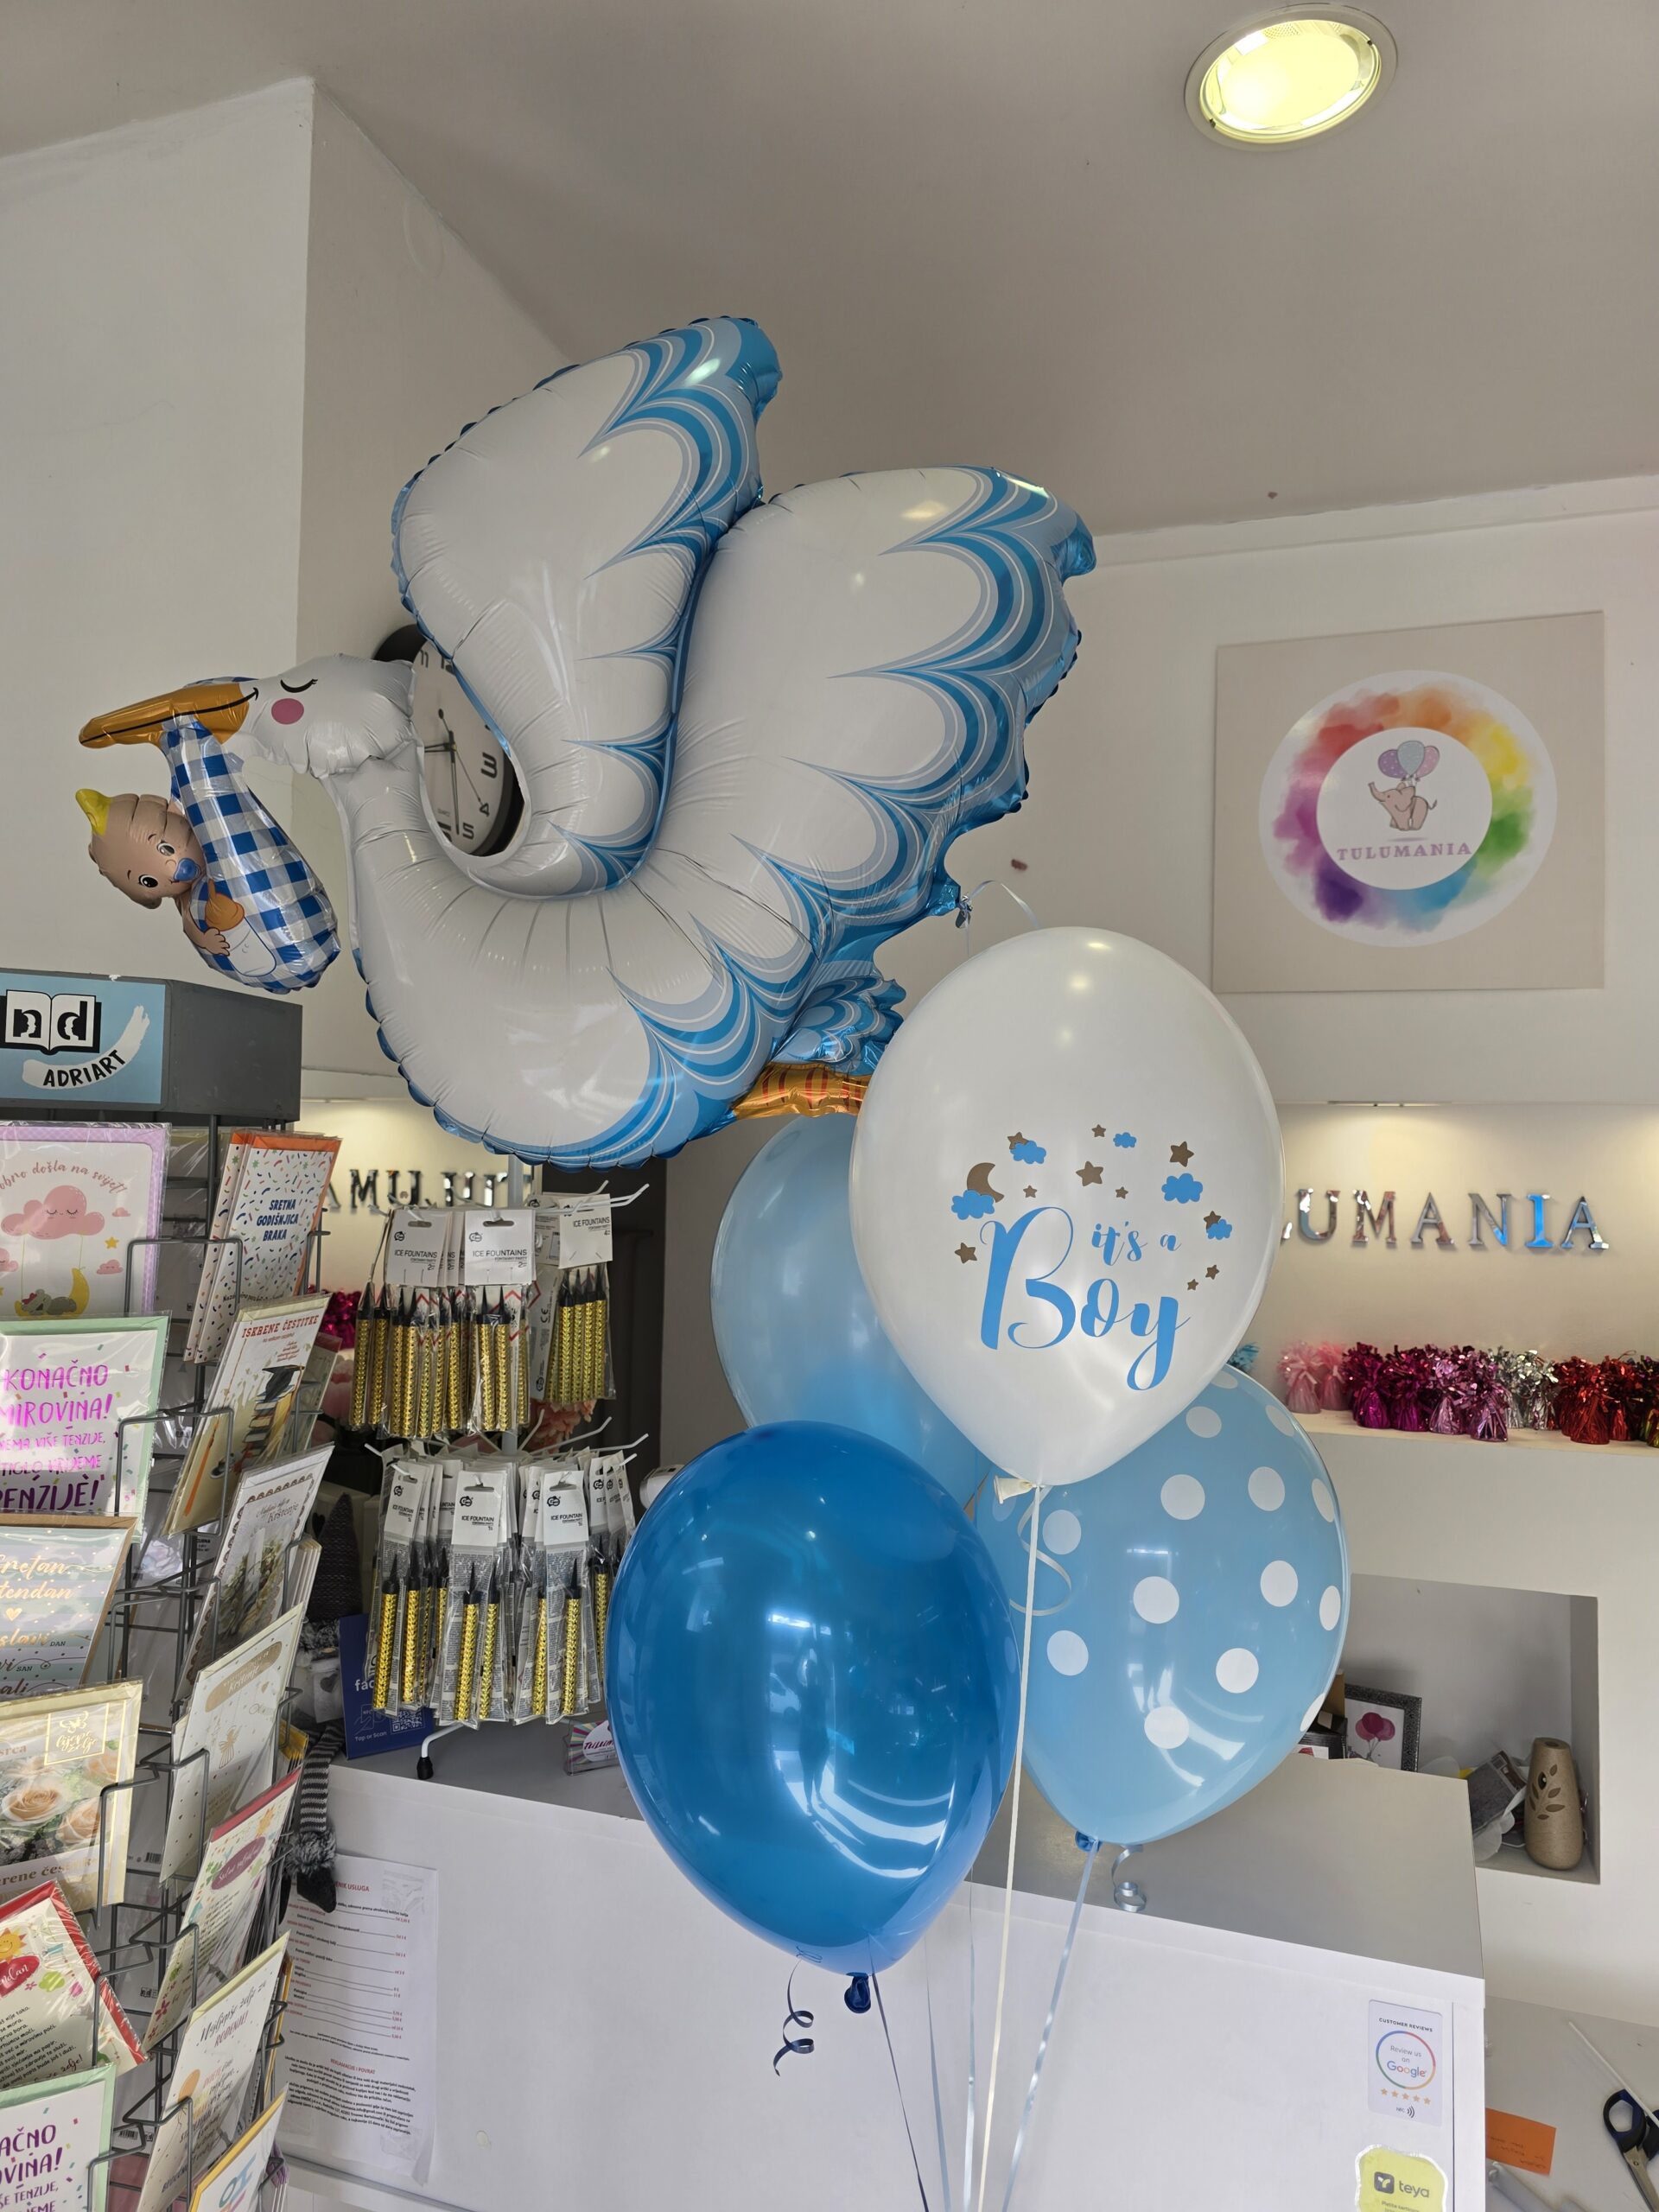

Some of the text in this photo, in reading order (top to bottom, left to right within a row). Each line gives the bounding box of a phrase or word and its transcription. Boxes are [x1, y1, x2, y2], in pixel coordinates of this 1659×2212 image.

[1337, 842, 1472, 861] TULUMANIA
[43, 1049, 126, 1087] ADRIART
[32, 1160, 67, 1174] došla
[71, 1166, 89, 1175] na
[269, 1198, 296, 1211] SRETNA
[257, 1211, 299, 1226] GODIŠNJICA
[582, 1217, 610, 1226] FOUNTAINS
[1281, 1187, 1609, 1249] UMANIA
[263, 1229, 288, 1242] BRAKA
[1091, 1220, 1182, 1266] it's a
[404, 1249, 437, 1259] FOUNTAINS
[980, 1206, 1192, 1391] Boy
[241, 1314, 320, 1339] ISKRENE ČESTITKE
[4, 1359, 109, 1391] KONAČNO
[35, 1432, 59, 1447] VIŠE
[62, 1432, 105, 1446] TENZIJE,
[0, 1869, 36, 1886] rene
[347, 1883, 370, 1892] USLUGA
[1379, 2018, 1433, 2032] CUSTOMER REVIEWS
[1390, 2045, 1413, 2056] Review
[1387, 2060, 1427, 2078] Google
[0, 2125, 56, 2157] AČNO
[0, 2147, 63, 2184] VINA!
[15, 2181, 59, 2203] TENZIJE,
[1399, 2180, 1429, 2198] teya
